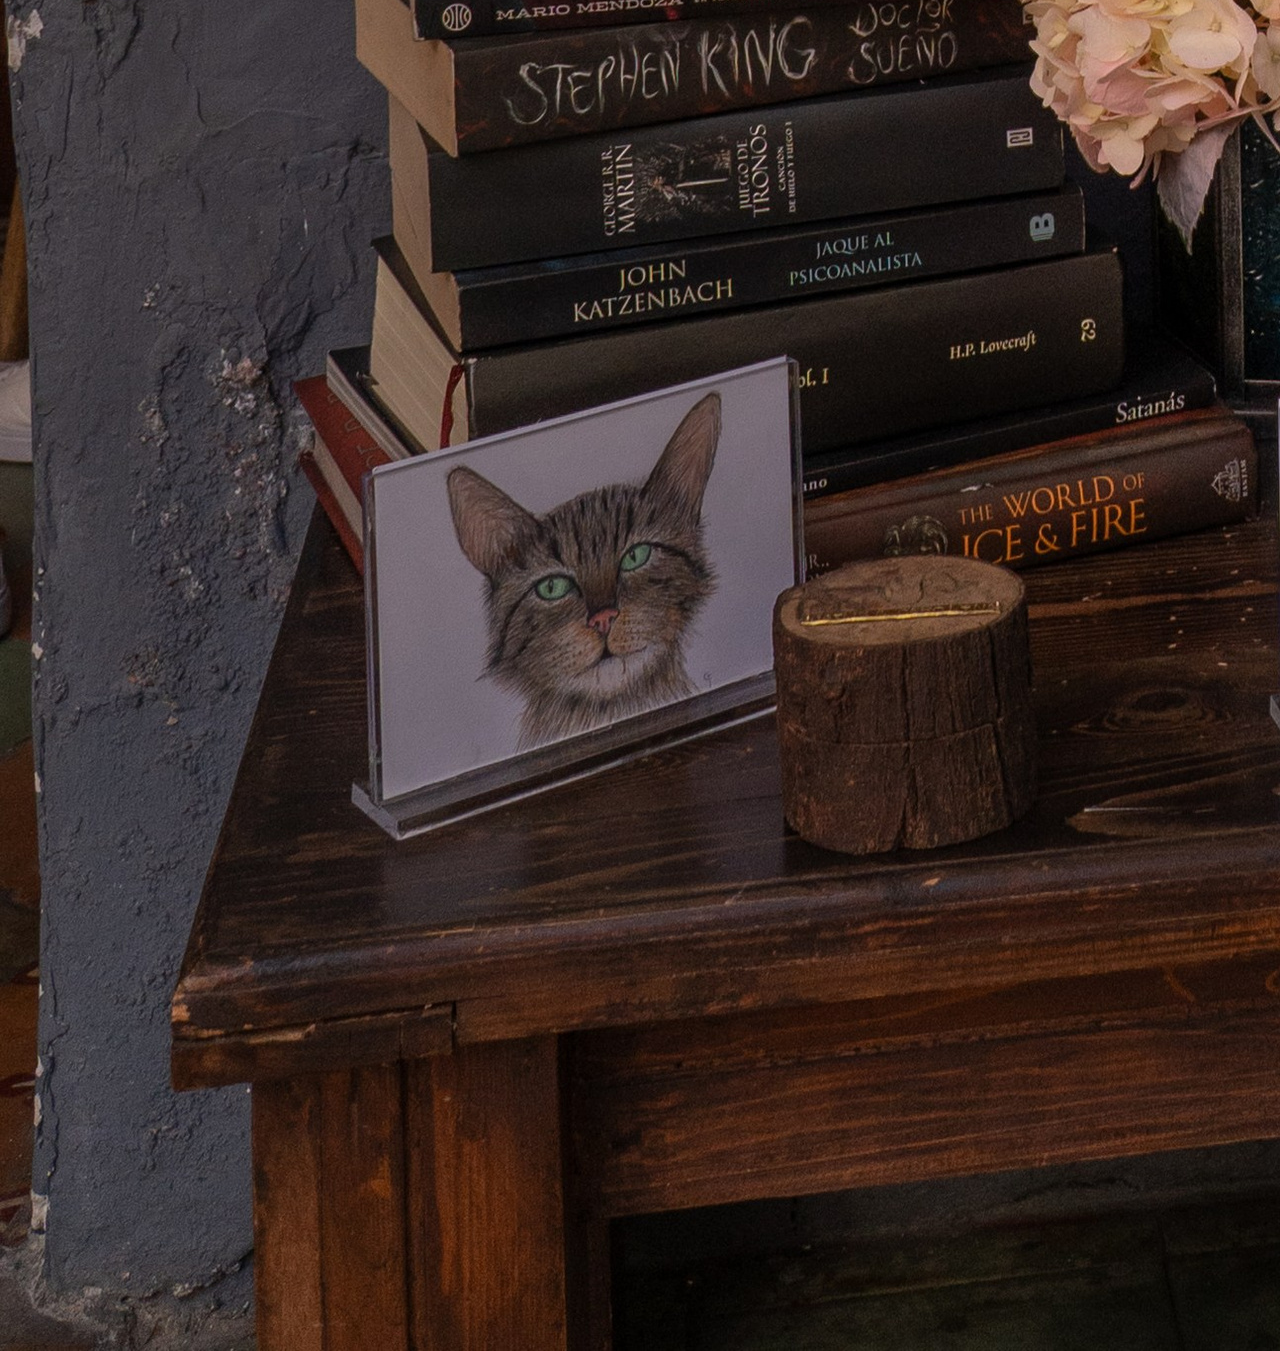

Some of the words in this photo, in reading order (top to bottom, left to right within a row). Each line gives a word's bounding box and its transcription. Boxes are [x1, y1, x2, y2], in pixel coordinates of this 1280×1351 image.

[496, 4, 570, 21] MARIO
[505, 40, 681, 125] STEPHEN
[699, 15, 817, 98] KING
[614, 143, 636, 234] MARTIN
[737, 162, 753, 210] JUEGO
[749, 123, 771, 218] TRONOS
[602, 177, 617, 236] GEORGE
[816, 234, 869, 259] JAQUE
[874, 231, 894, 248] AL
[619, 258, 687, 293] JOHN
[789, 251, 922, 286] PSICOANALISTA
[573, 277, 733, 323] KATZENBACH
[980, 329, 1037, 355] Lovecraft
[798, 367, 817, 389] ol.
[1116, 390, 1185, 424] Satanás
[958, 502, 994, 527] THE
[1003, 474, 1115, 518] WORLD
[963, 527, 1024, 565] ICE
[1071, 498, 1148, 548] FIRE
